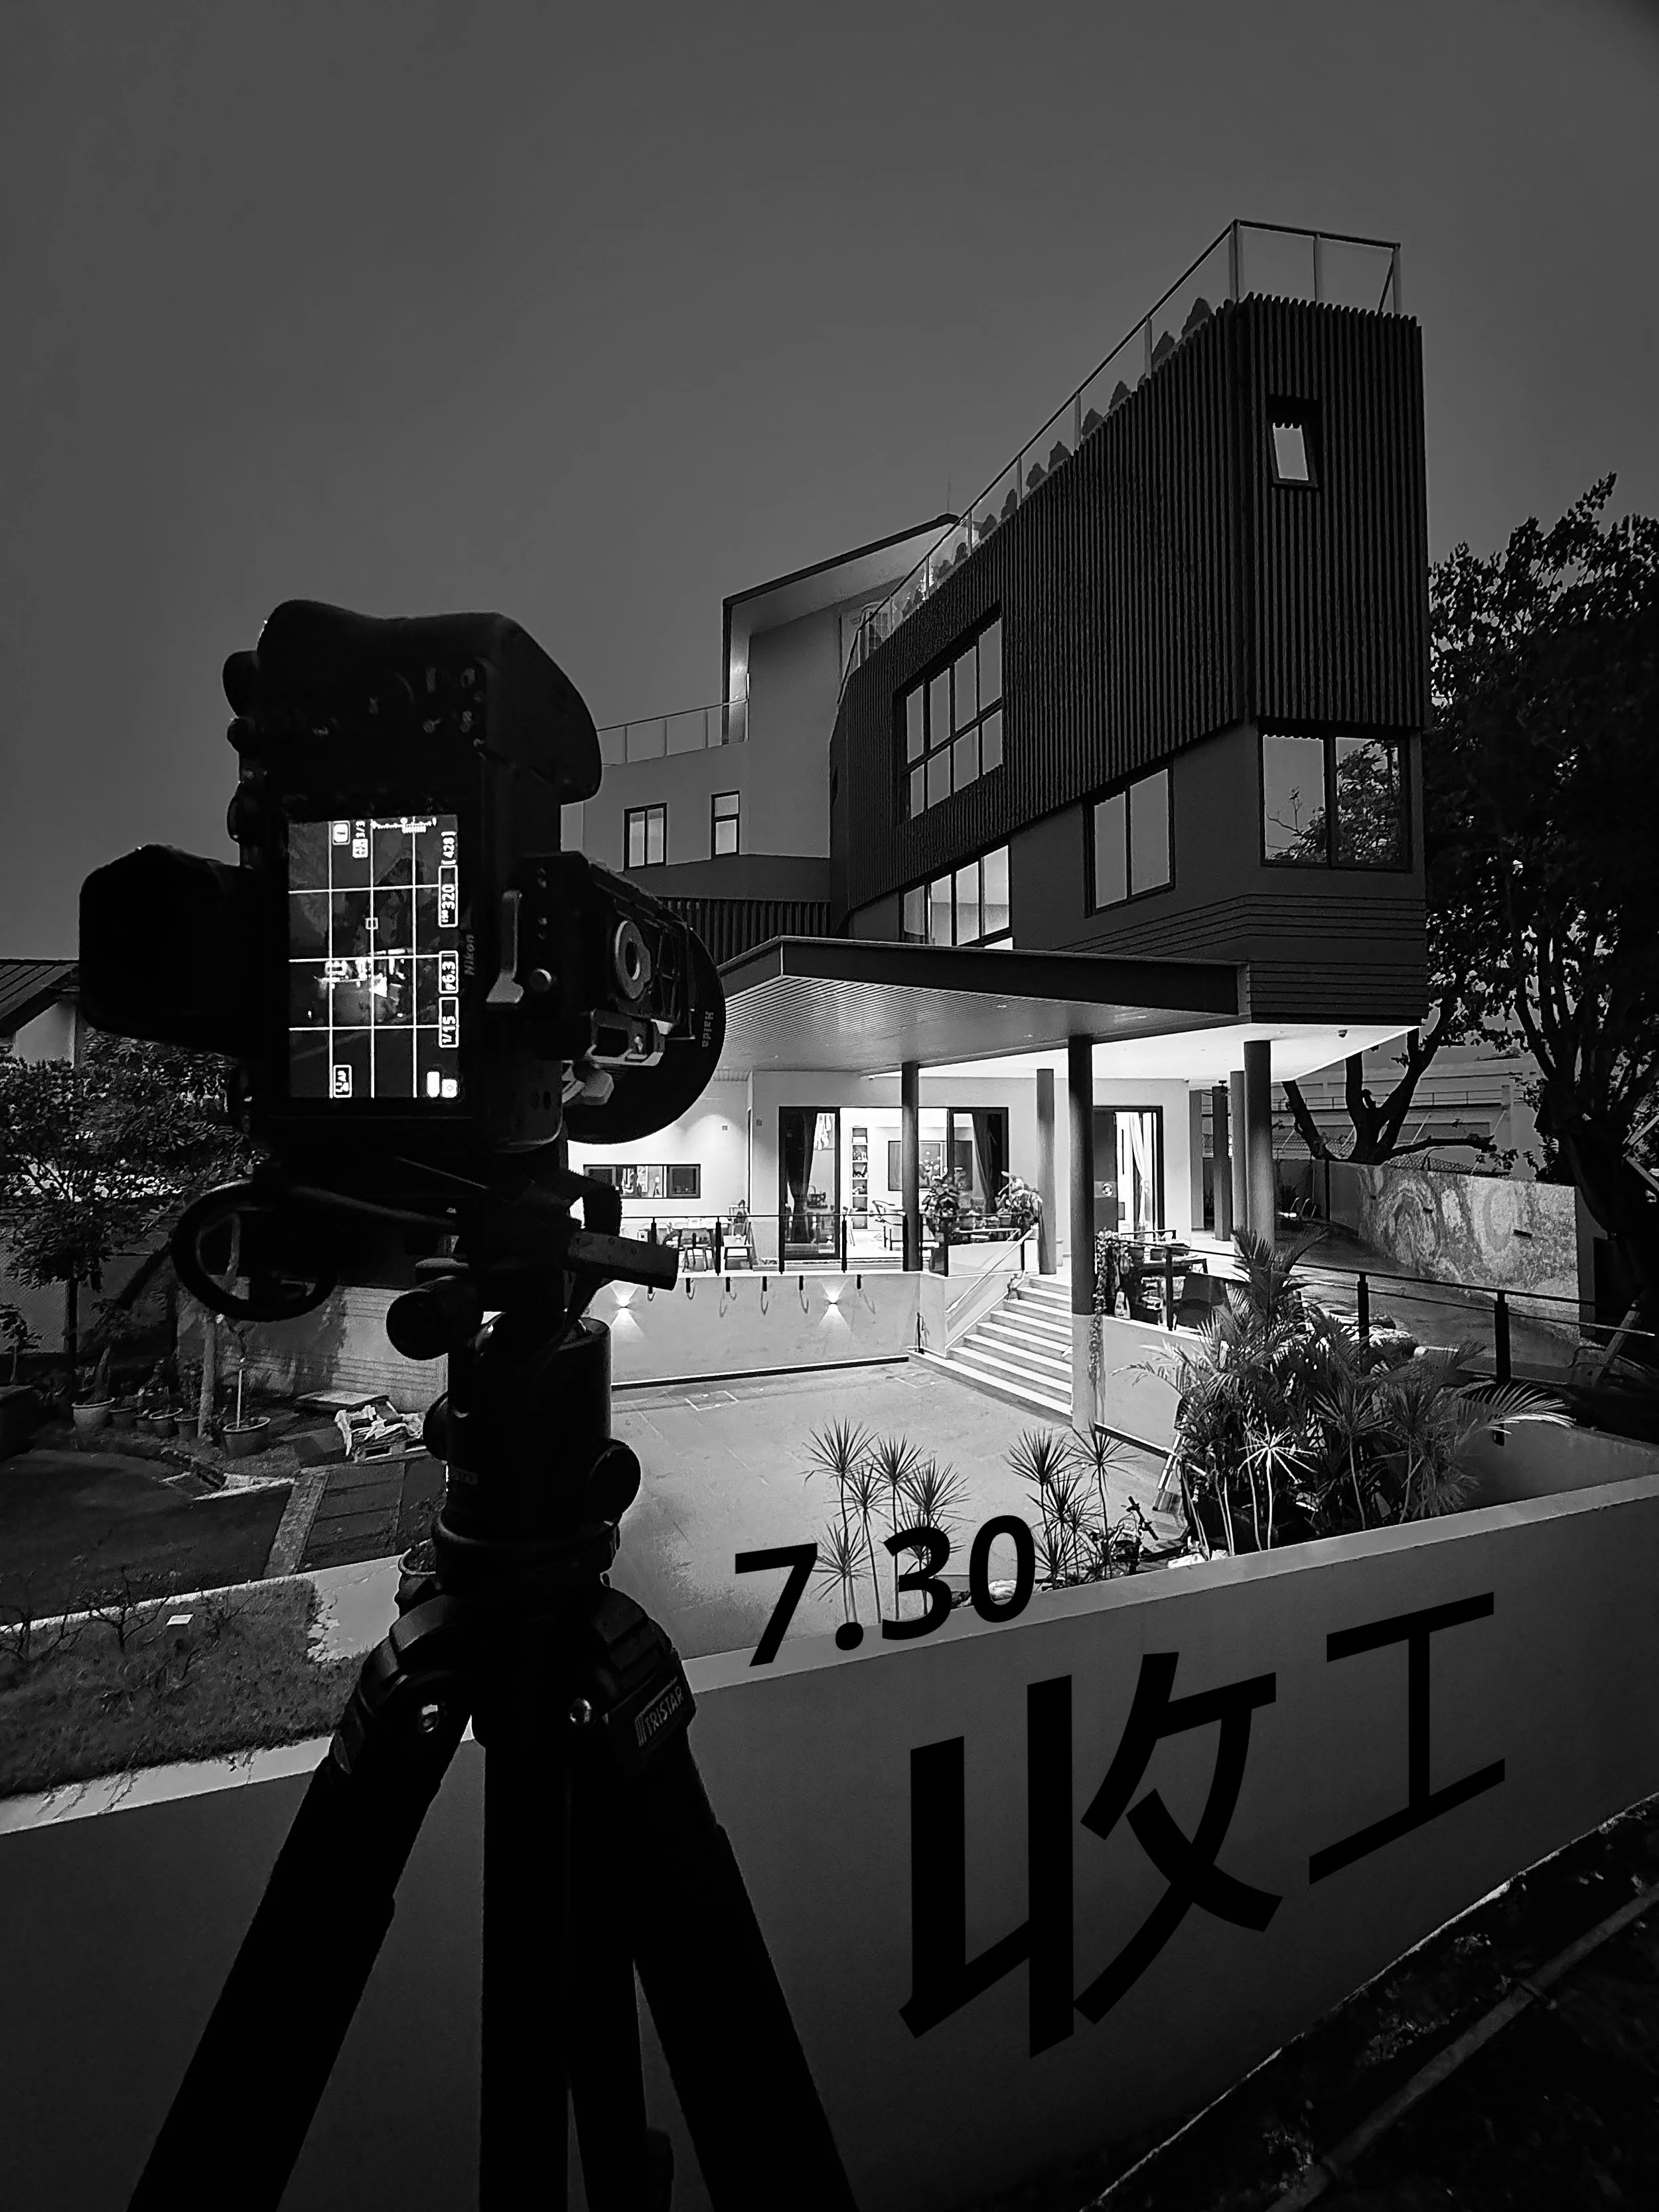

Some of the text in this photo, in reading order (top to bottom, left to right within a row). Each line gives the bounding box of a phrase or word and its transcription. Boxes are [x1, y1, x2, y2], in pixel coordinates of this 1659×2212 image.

[463, 934, 475, 976] Nikon
[442, 1015, 456, 1044] 1/15
[645, 1686, 684, 1736] TRISTAR
